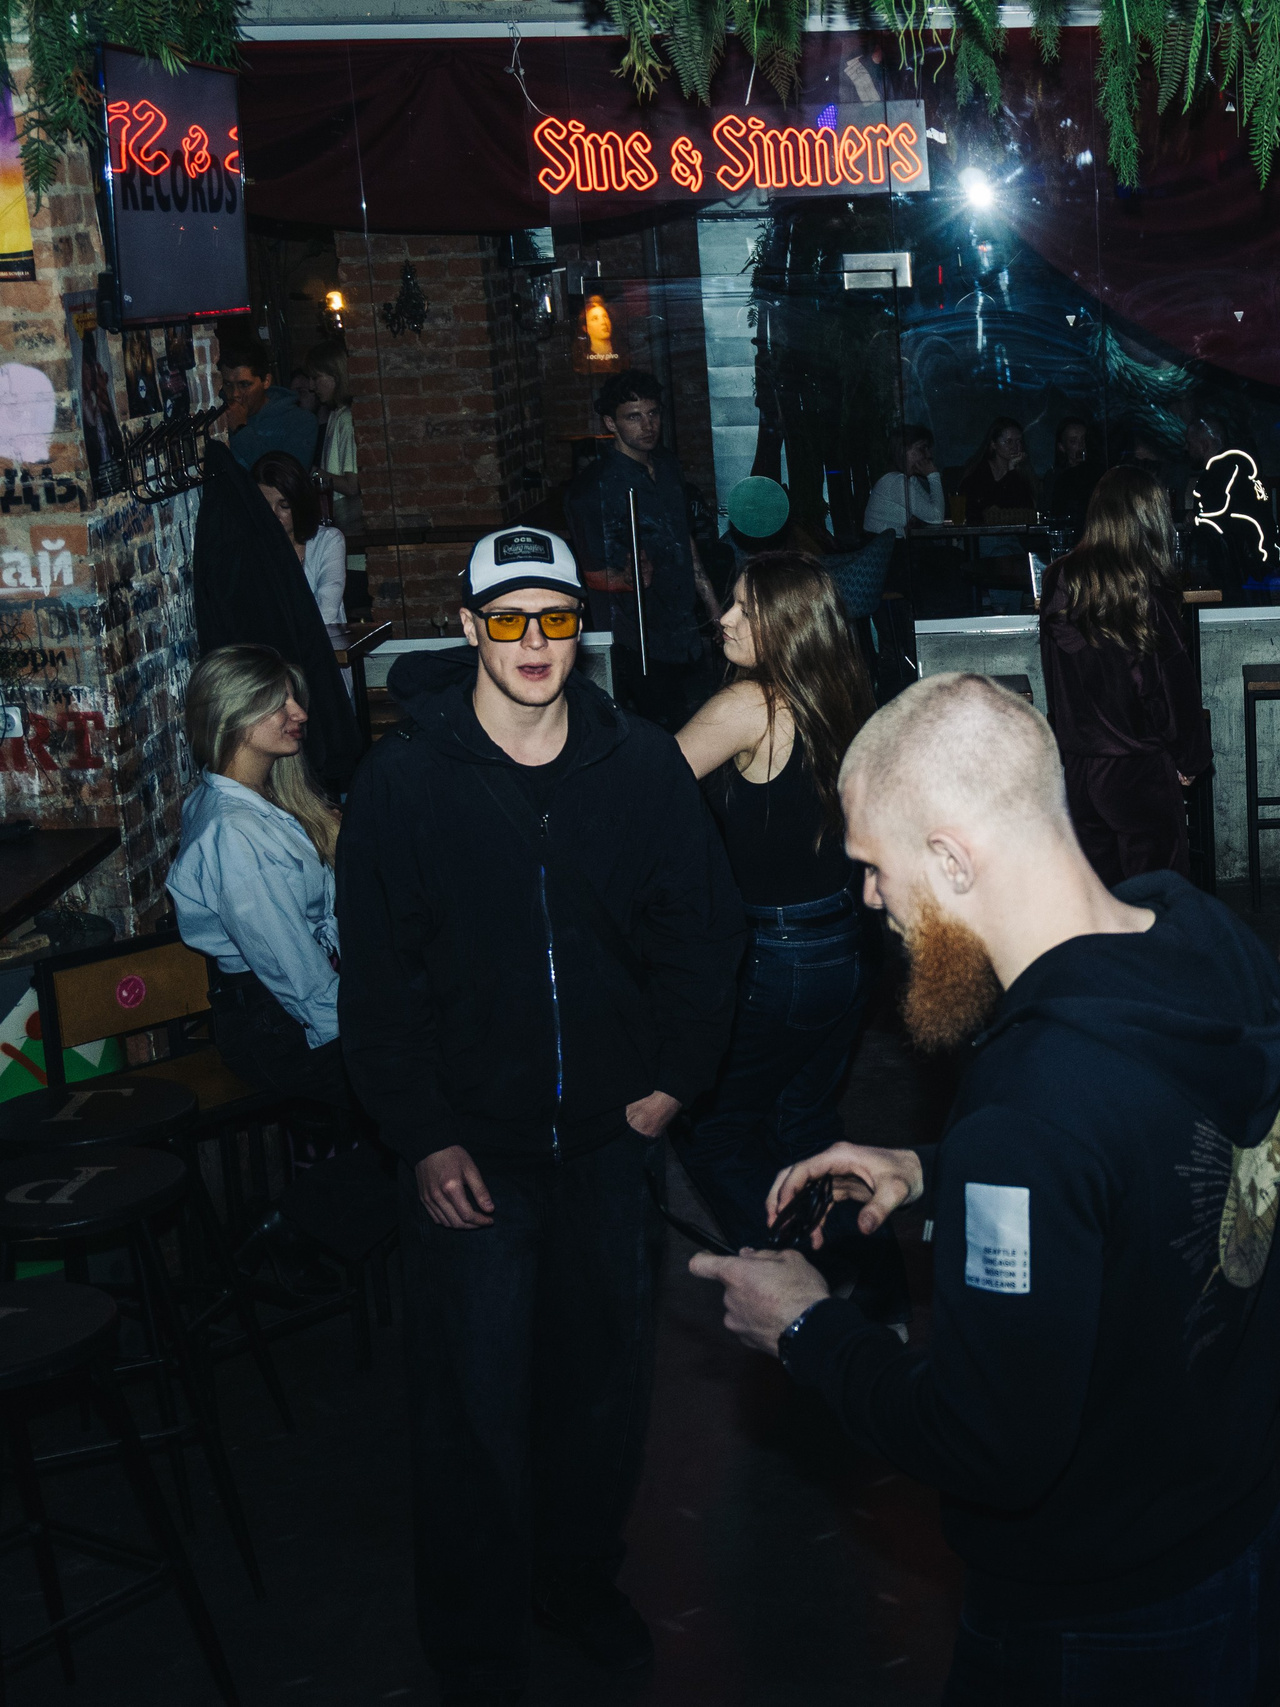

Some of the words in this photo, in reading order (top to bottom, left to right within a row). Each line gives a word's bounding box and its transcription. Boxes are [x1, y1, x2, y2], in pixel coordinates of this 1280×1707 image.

[534, 117, 658, 194] Sins
[671, 136, 702, 192] &
[713, 115, 922, 191] Sinners
[119, 146, 238, 214] RECORDS
[984, 1247, 1016, 1255] SEATTLE
[984, 1268, 1016, 1277] BOSTON
[982, 1278, 1016, 1288] ORLEANS
